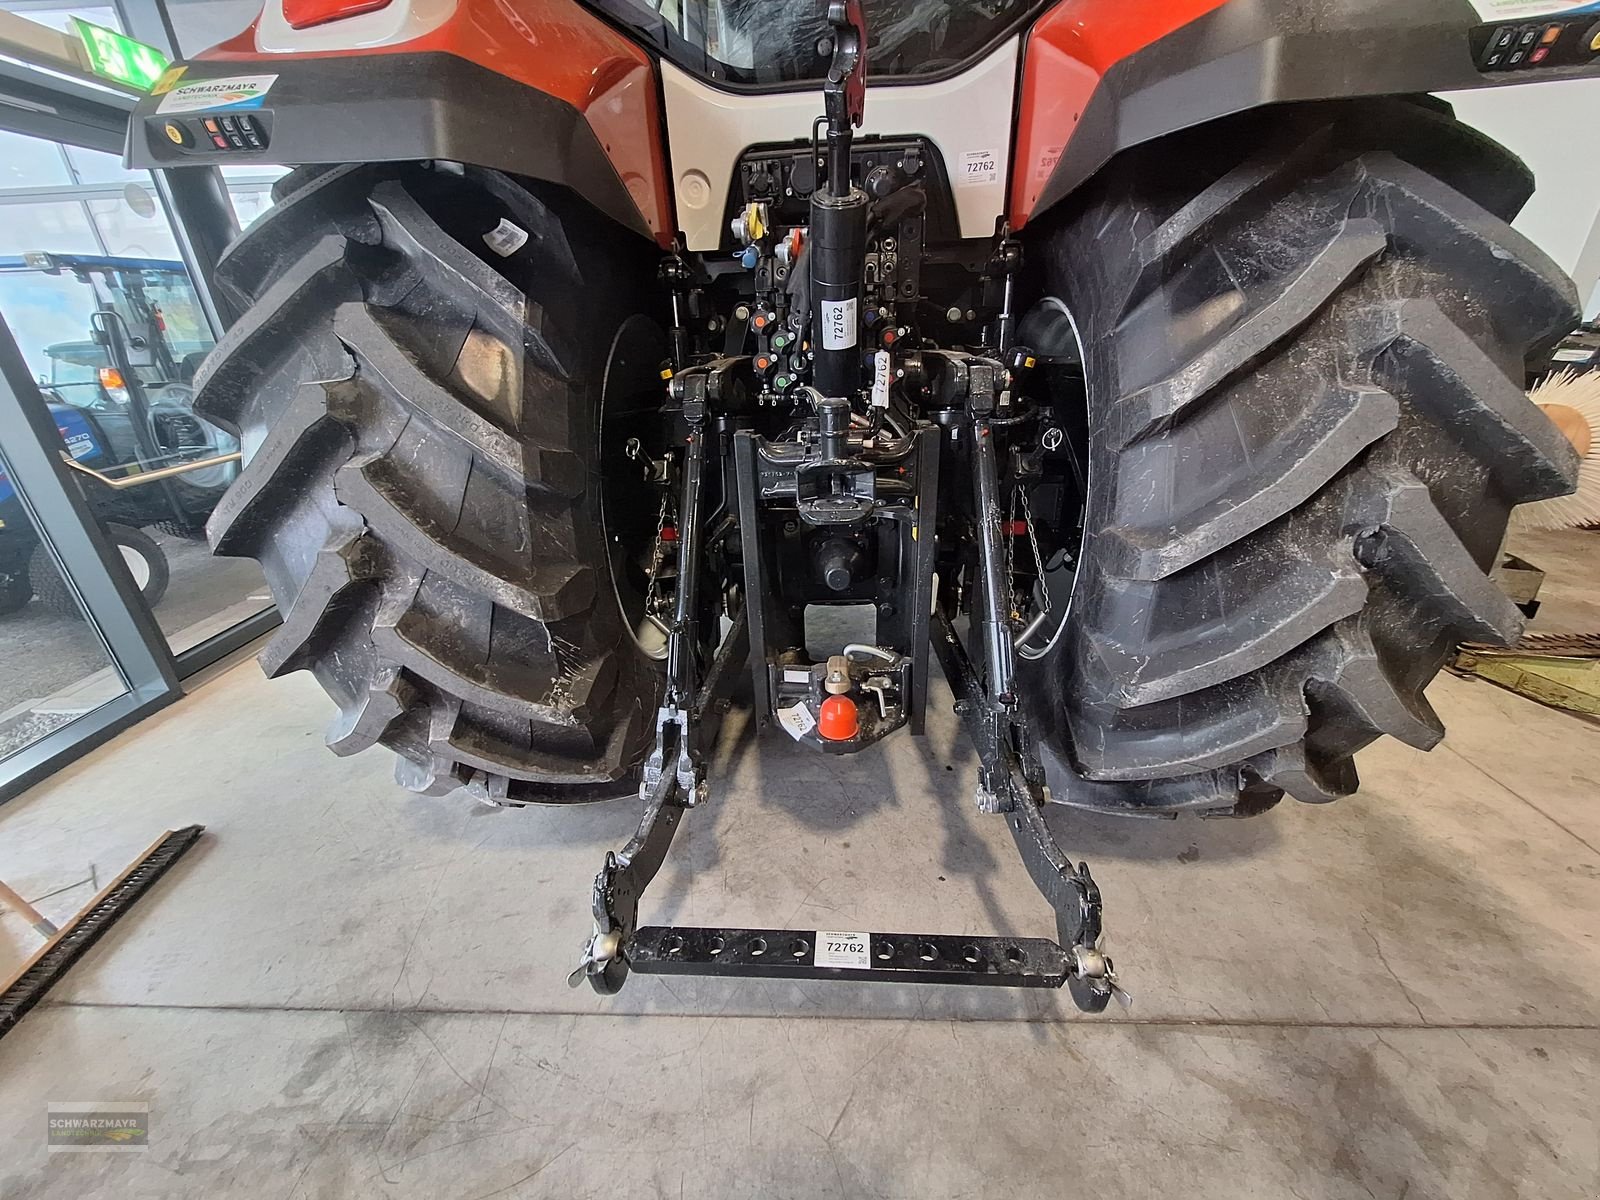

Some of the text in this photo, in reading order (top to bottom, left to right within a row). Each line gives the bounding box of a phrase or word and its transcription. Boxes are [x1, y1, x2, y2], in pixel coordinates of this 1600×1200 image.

[176, 83, 257, 95] SCHWARZMAYR
[967, 161, 994, 172] 72762
[833, 307, 844, 340] 72762
[875, 357, 888, 393] 72762
[791, 713, 807, 731] 72762
[827, 942, 864, 953] 72762
